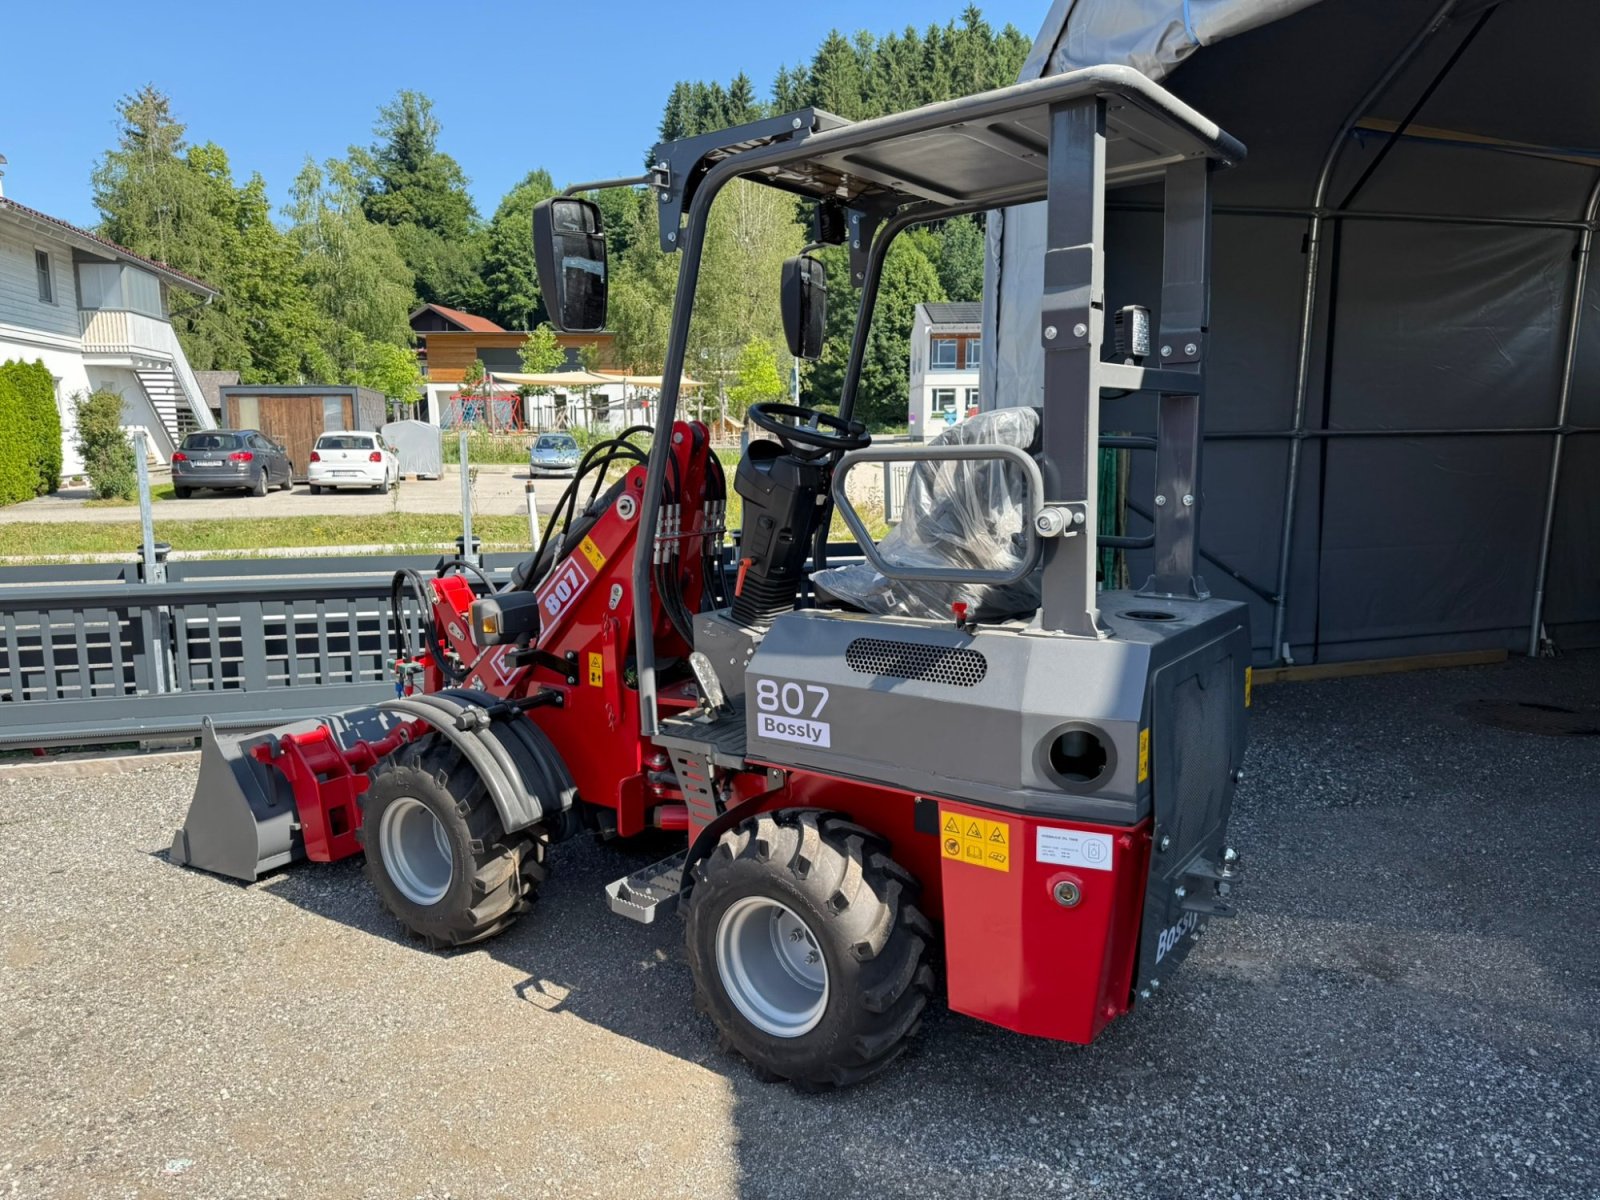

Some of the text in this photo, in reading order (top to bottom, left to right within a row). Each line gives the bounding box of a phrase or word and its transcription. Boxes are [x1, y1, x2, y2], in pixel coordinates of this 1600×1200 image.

[545, 568, 579, 616] 807
[756, 679, 829, 718] 807
[765, 718, 822, 742] Bossly
